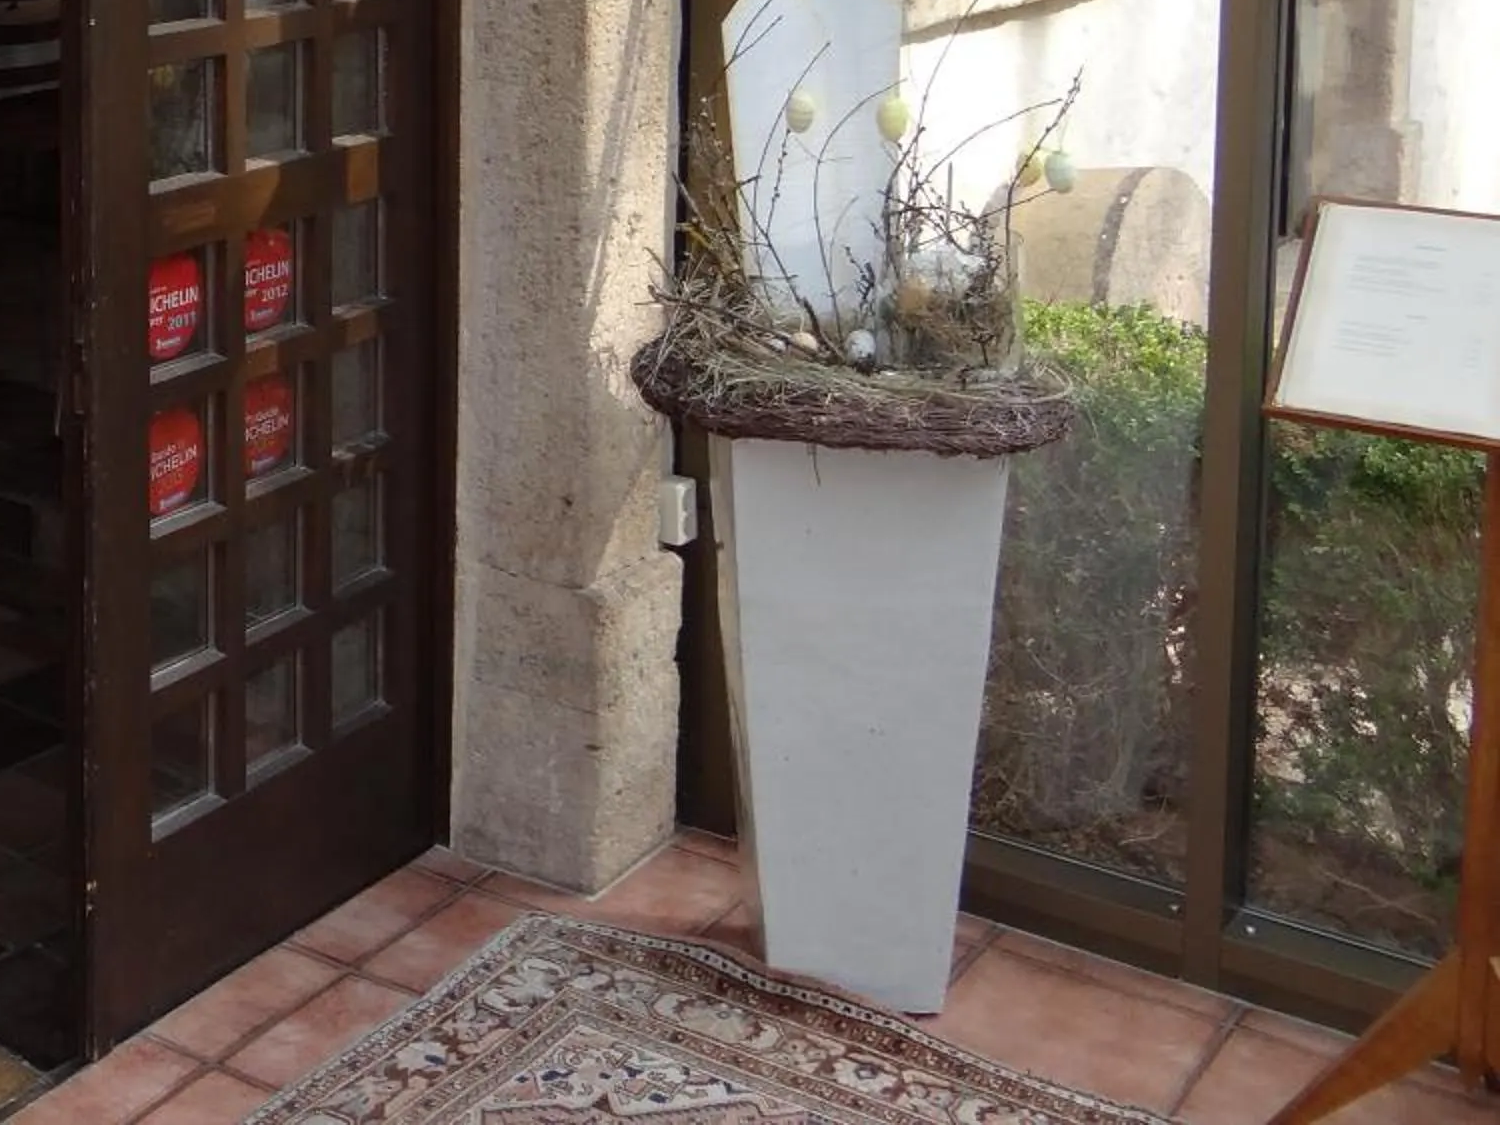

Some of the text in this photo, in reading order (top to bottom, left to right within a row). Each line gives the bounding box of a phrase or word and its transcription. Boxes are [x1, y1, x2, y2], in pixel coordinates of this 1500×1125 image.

[245, 261, 290, 286] ICHELIN
[149, 285, 199, 313] ICHELIN
[261, 283, 289, 302] 2012
[168, 311, 197, 331] 2011
[245, 414, 290, 442] ICHELIN
[150, 444, 197, 481] ICHELIN
